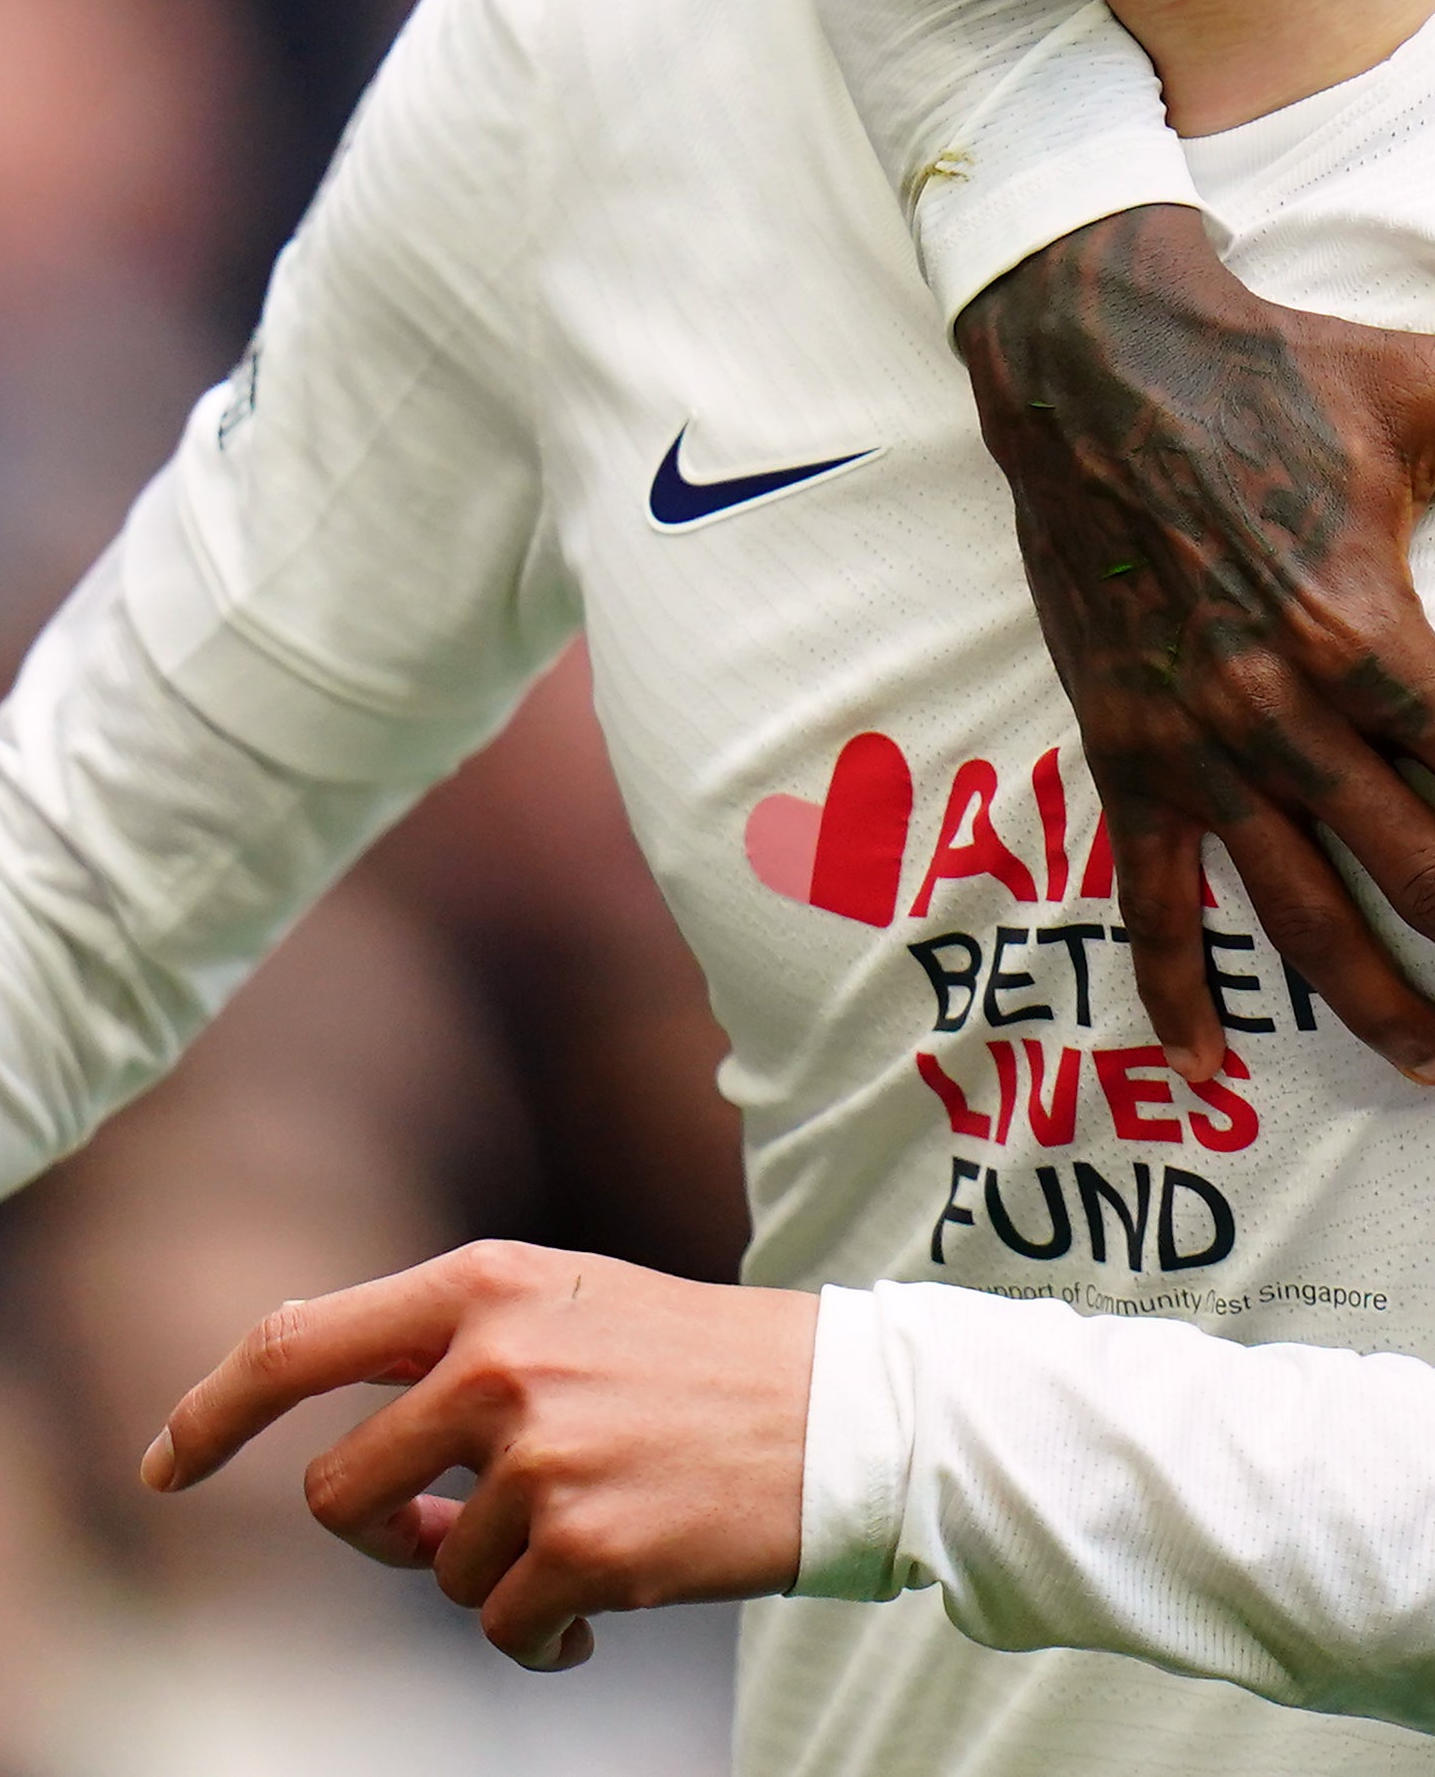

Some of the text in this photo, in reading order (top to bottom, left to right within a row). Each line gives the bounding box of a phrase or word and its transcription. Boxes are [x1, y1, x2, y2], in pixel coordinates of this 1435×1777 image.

[915, 1037, 1260, 1153] LIVES
[931, 1156, 1237, 1273] FUND
[1061, 1281, 1081, 1304] of
